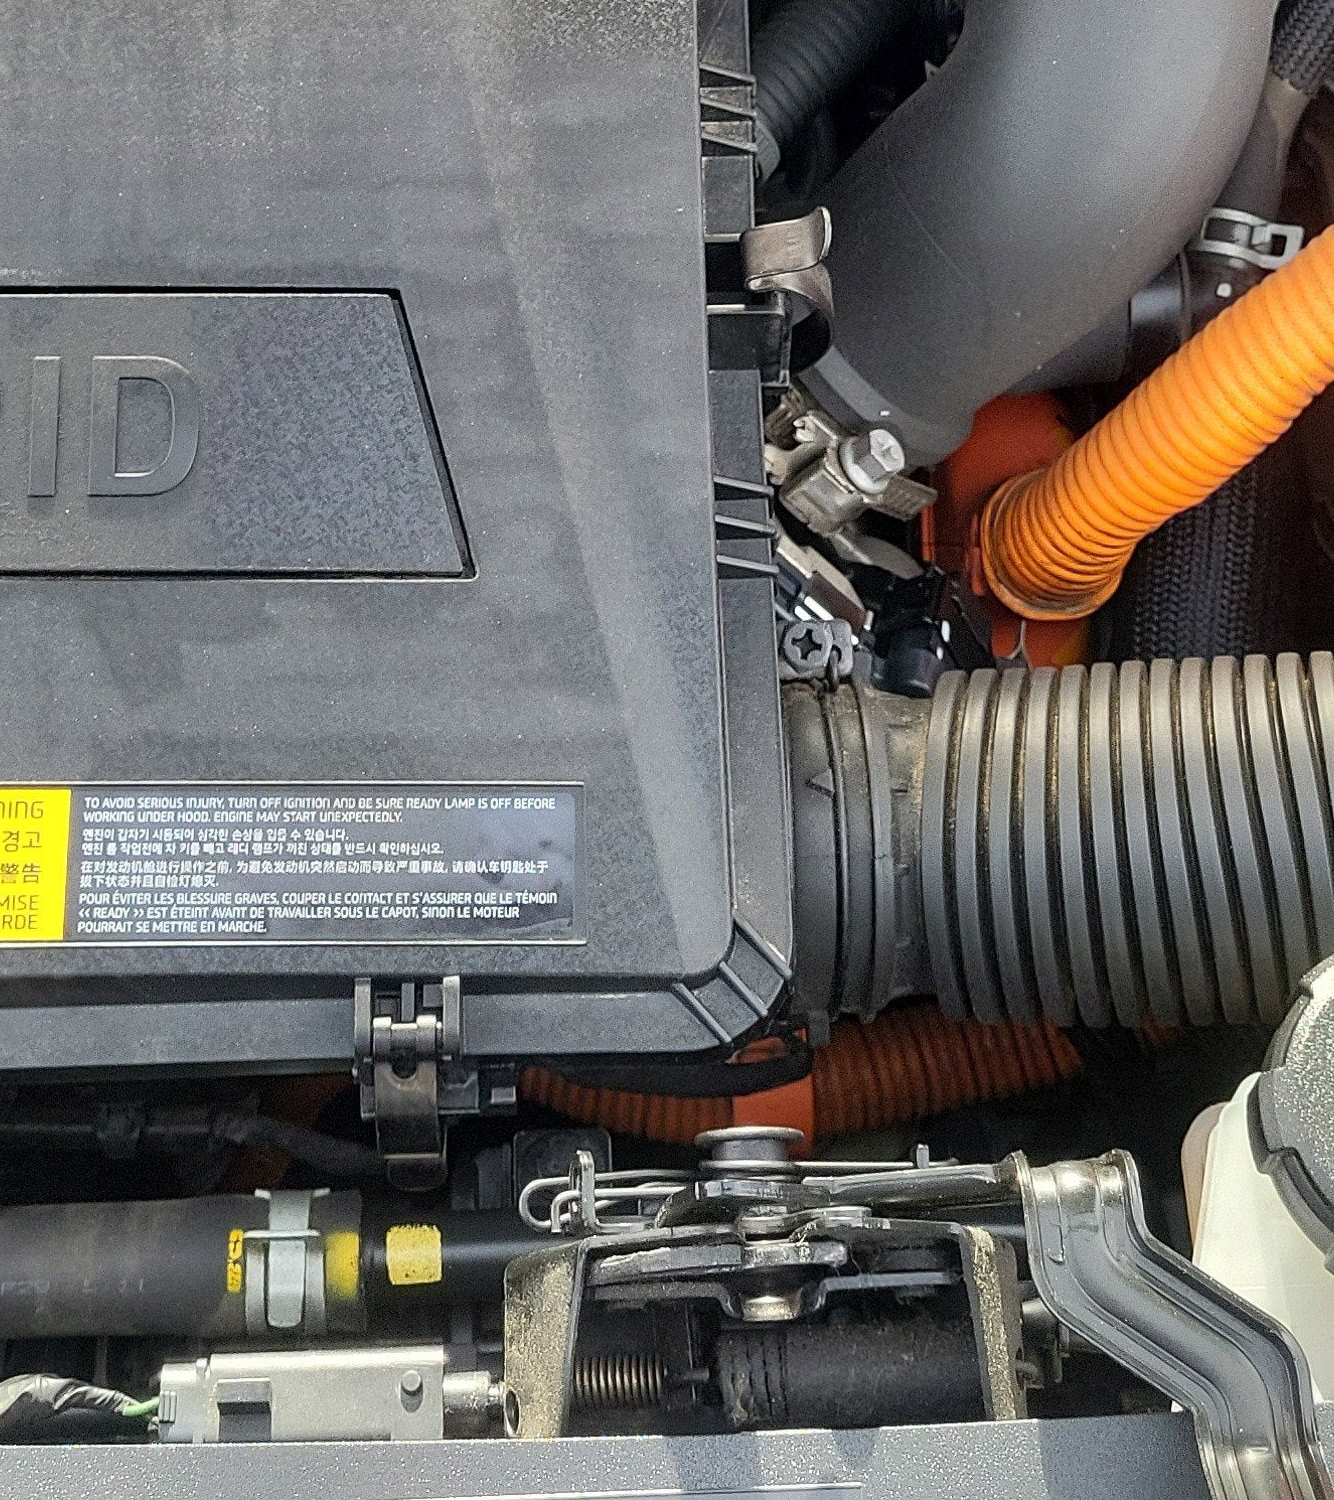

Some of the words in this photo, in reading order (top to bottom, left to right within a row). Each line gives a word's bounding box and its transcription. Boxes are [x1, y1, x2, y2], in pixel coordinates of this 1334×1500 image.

[84, 797, 100, 809] TO
[101, 797, 136, 809] AVOID
[137, 797, 184, 809] SERIOUS
[185, 797, 225, 809] INJURY,
[227, 797, 258, 809] TURN
[259, 797, 282, 809] OFF
[283, 797, 331, 809] IGNITION
[333, 797, 357, 809] AND
[358, 797, 374, 809] BE
[375, 797, 404, 809] SURE
[405, 797, 443, 809] READY
[444, 797, 476, 809] LAMP
[477, 797, 489, 809] IS
[490, 797, 512, 809] OFF
[513, 797, 556, 809] BEFORE
[83, 810, 135, 822] WORKING
[137, 810, 175, 822] UNDER
[177, 810, 211, 822] HOOD.
[213, 810, 254, 822] ENGINE
[256, 810, 281, 822] MAY
[282, 810, 317, 822] START
[319, 810, 403, 822] UNEXPECTEDLY.
[82, 828, 115, 841] 엔진이
[118, 828, 149, 841] 갑자기
[152, 828, 195, 841] 시동되어
[197, 828, 229, 841] 심각한
[231, 828, 263, 841] 손상을
[266, 828, 287, 841] 입을
[290, 828, 302, 841] 수
[304, 828, 350, 841] 있습니다.
[2, 830, 42, 853] 경고
[81, 842, 104, 855] 엔진
[286, 842, 308, 855] 꺼진
[310, 842, 342, 855] 상태를
[344, 842, 376, 855] 반드시
[378, 842, 444, 855] 확인하십시오.
[0, 863, 42, 884] 警告
[78, 892, 110, 904] POUR
[112, 889, 152, 904] ÉVITER
[154, 892, 175, 904] LES
[176, 892, 232, 904] BLESSURE
[282, 892, 326, 904] COUPER
[328, 892, 342, 904] LE
[344, 892, 394, 904] CONTACT
[395, 892, 411, 904] ET
[412, 892, 472, 904] S'ASSURER
[474, 892, 497, 904] QUE
[499, 892, 513, 904] LE
[514, 889, 558, 904] TÉMOIN
[92, 906, 131, 918] READY
[146, 906, 169, 918] EST
[170, 903, 209, 918] ÉTEINT
[211, 906, 248, 918] AVANT
[249, 906, 265, 918] DE
[267, 906, 332, 918] TRAVAILLER
[333, 906, 364, 918] SOUS
[365, 906, 380, 918] LE
[421, 906, 455, 918] SINON
[456, 906, 471, 918] LE
[473, 906, 520, 918] MOTEUR
[76, 920, 134, 932] POURRAIT
[135, 920, 150, 932] SE
[151, 920, 198, 932] METTRE
[199, 920, 216, 932] EN
[217, 920, 267, 932] MARCHE.
